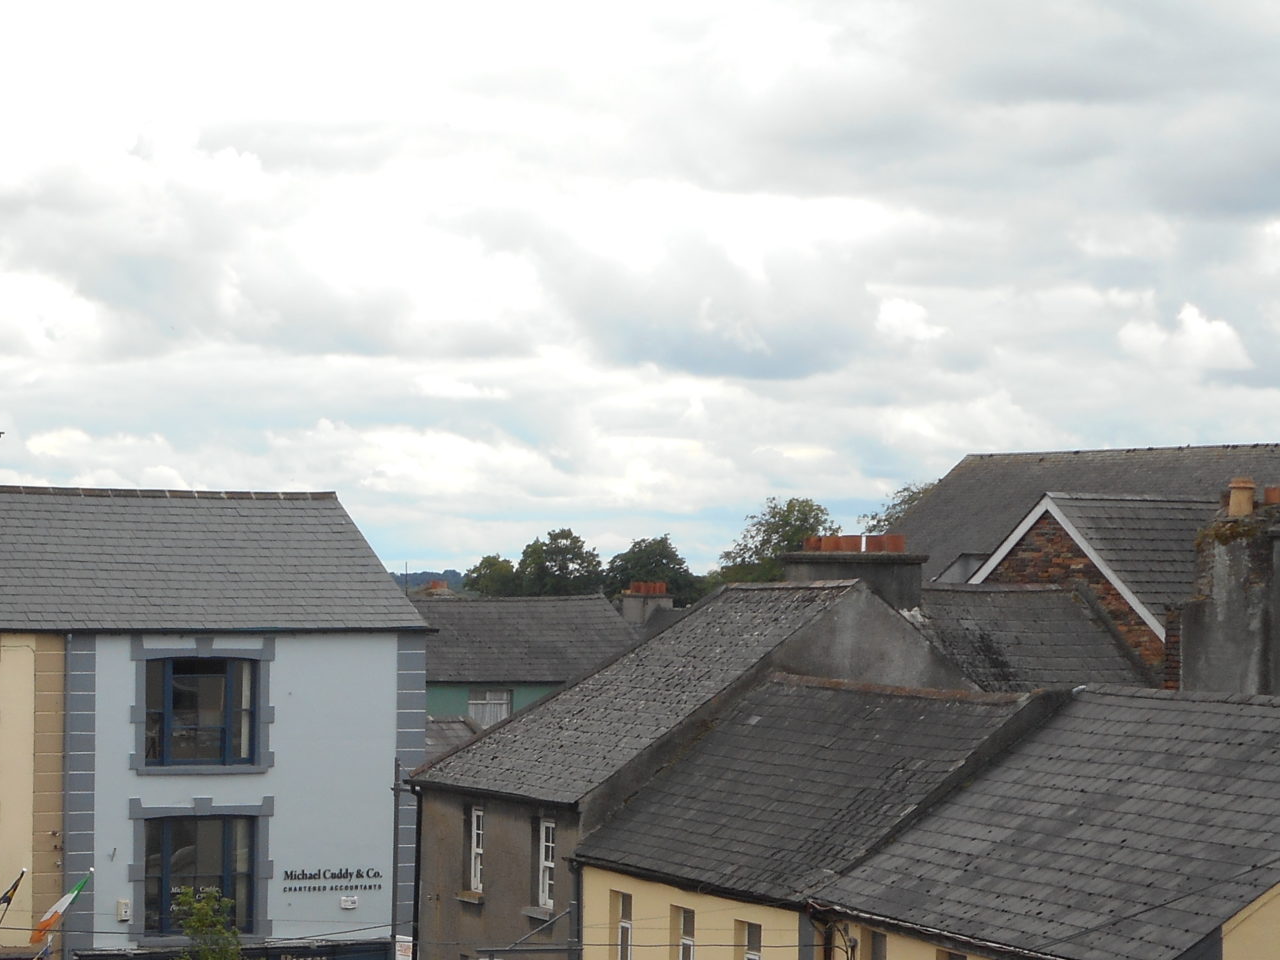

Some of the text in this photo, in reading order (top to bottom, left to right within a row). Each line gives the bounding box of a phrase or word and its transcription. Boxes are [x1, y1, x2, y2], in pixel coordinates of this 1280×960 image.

[283, 868, 383, 881] Michael Cuddy & Co.
